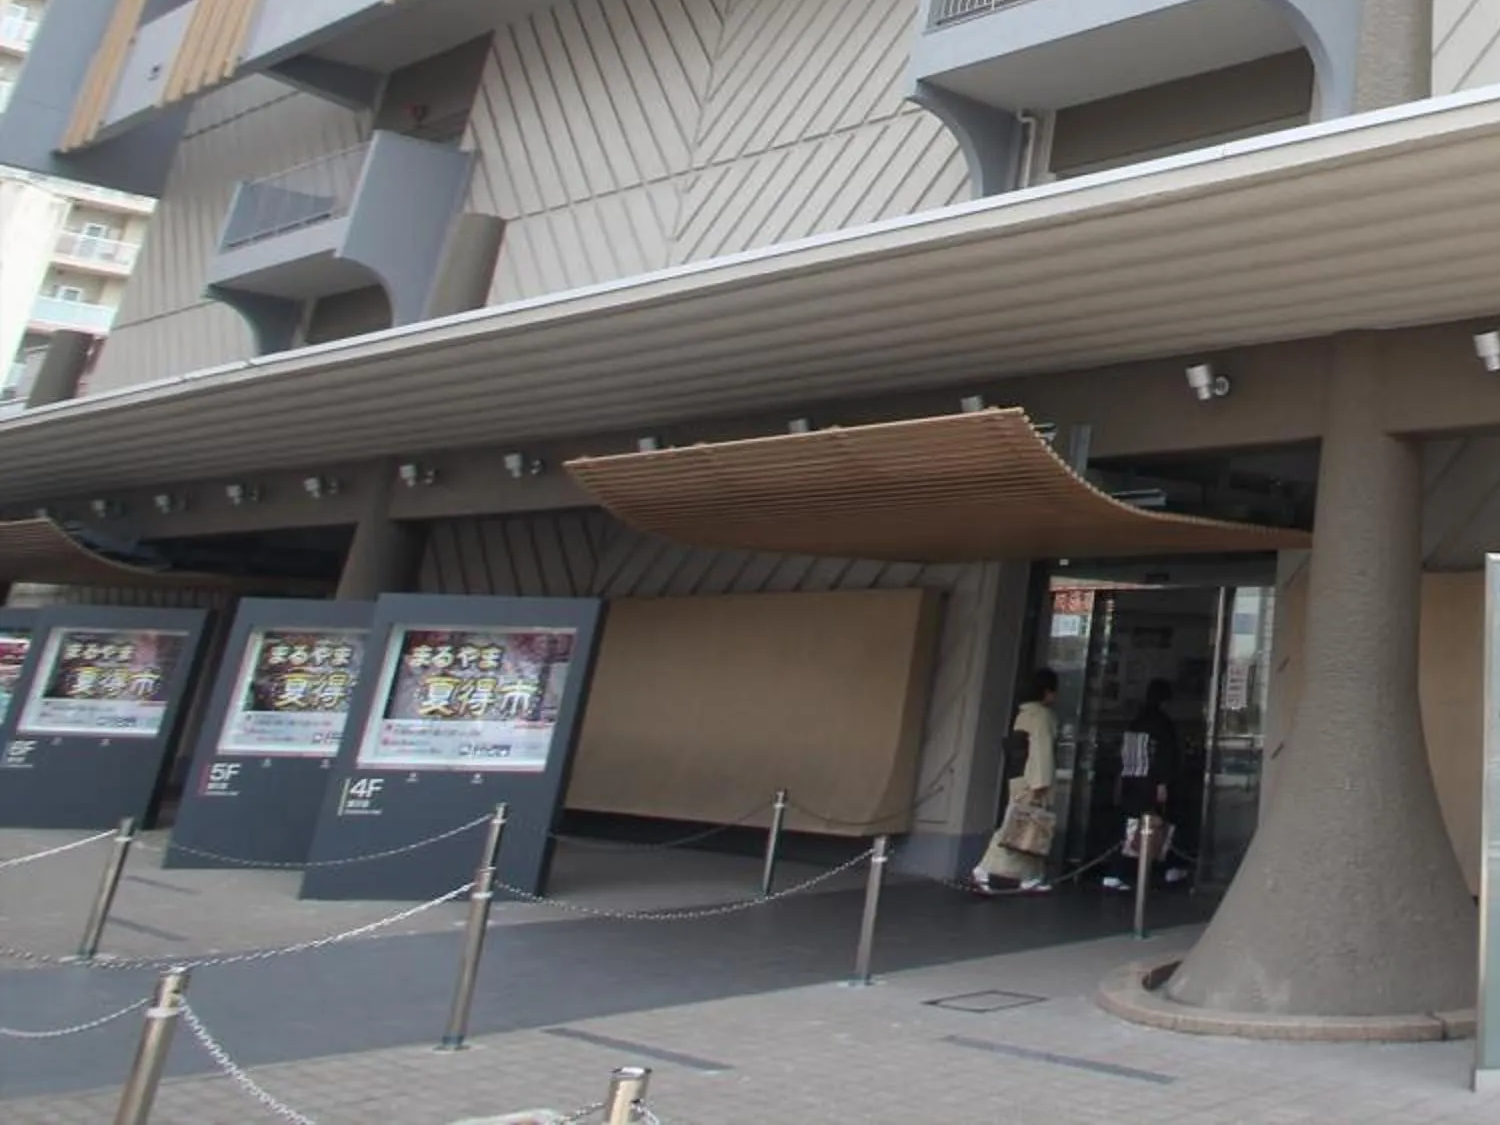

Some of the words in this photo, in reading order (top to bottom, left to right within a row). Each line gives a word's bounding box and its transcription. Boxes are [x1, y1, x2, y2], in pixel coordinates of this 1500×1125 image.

[267, 644, 352, 666] まるやま
[407, 644, 504, 671] まるやま
[273, 671, 358, 709] 夏得
[418, 675, 540, 717] 夏得市
[209, 762, 242, 781] 5F
[350, 778, 385, 798] 4F
